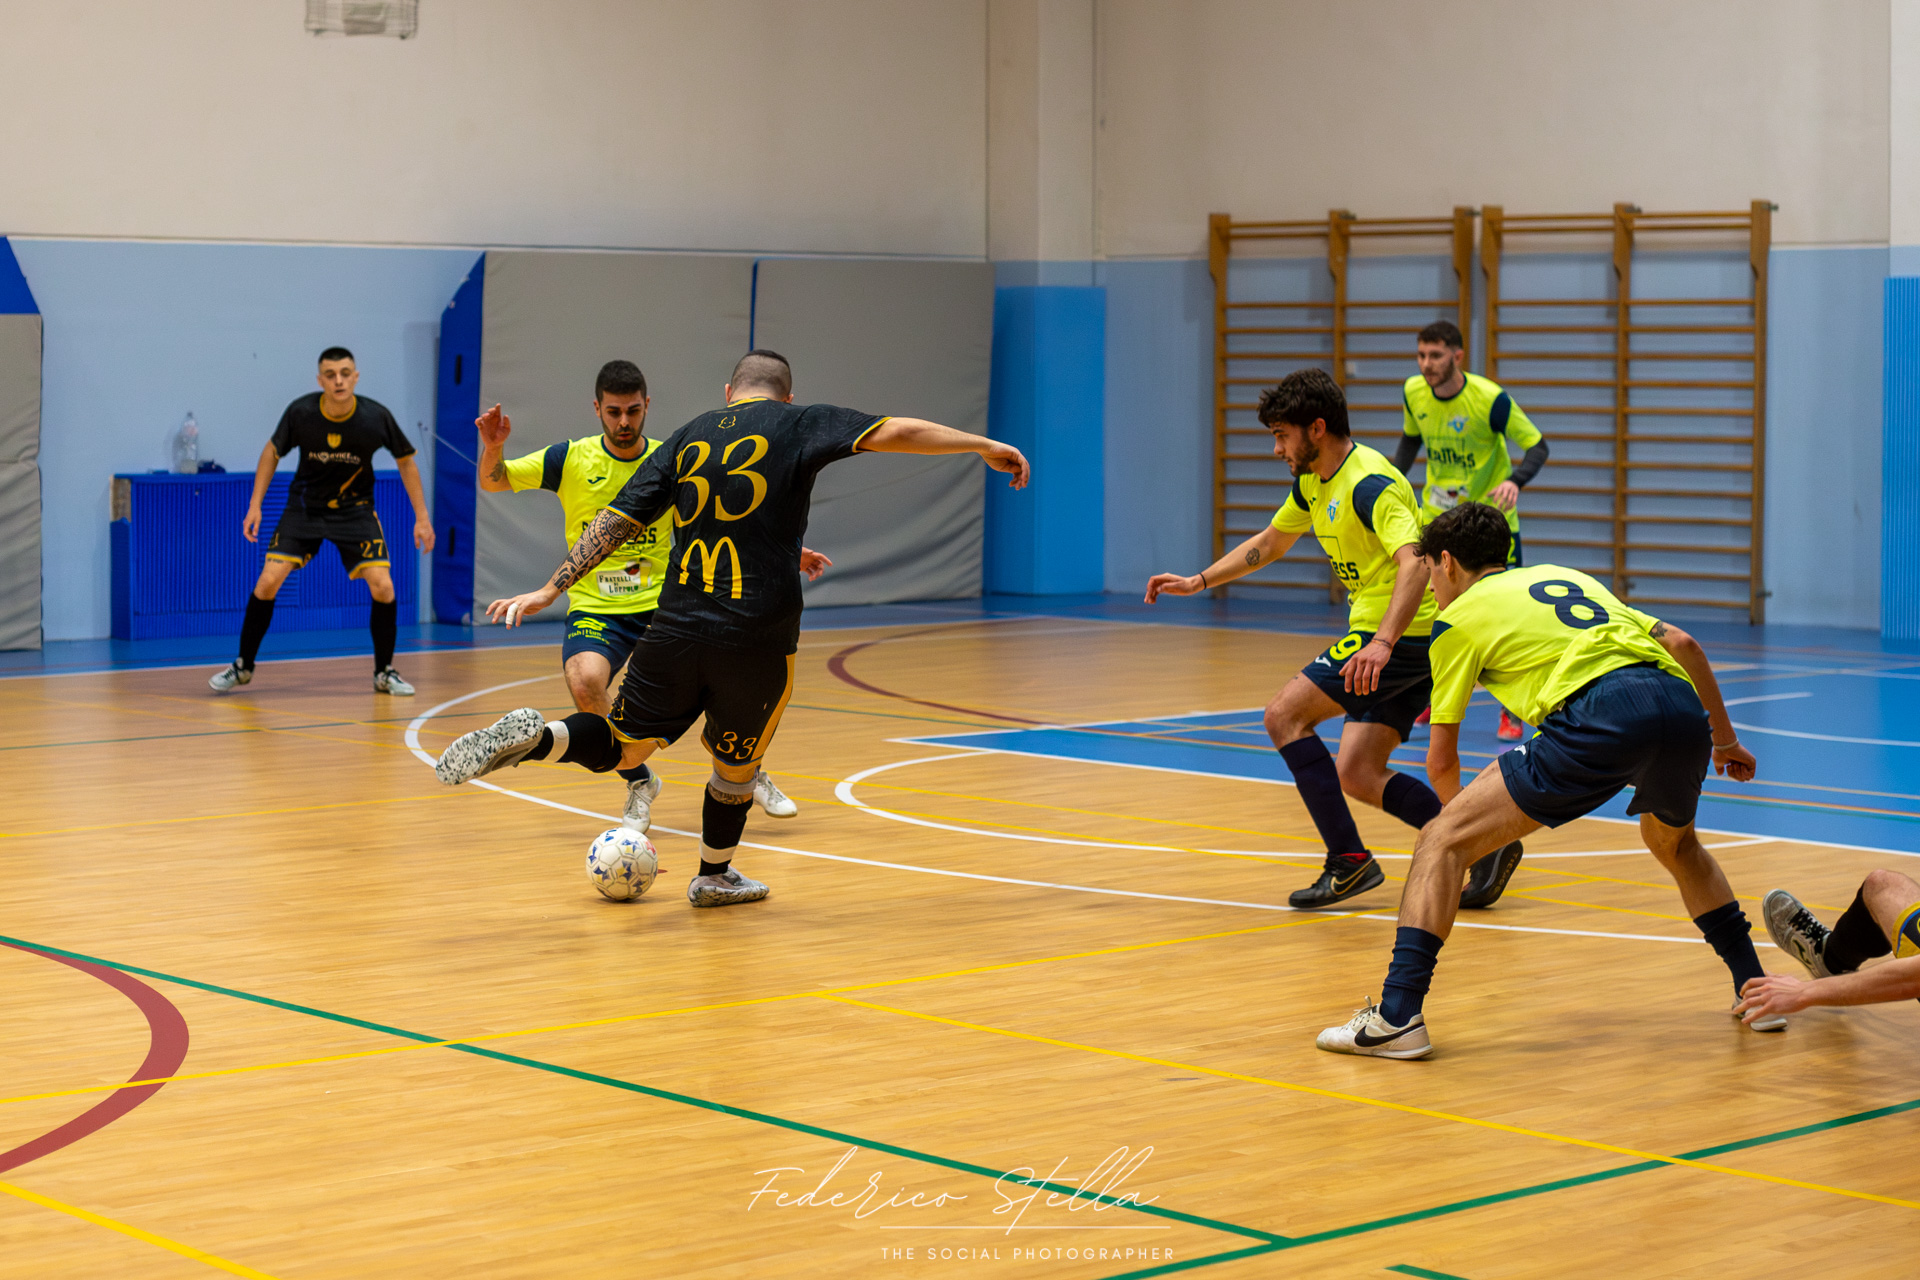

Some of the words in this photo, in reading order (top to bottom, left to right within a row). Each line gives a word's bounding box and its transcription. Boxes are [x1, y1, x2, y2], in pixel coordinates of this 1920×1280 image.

[673, 434, 769, 528] 33
[360, 539, 383, 558] 27
[1528, 579, 1610, 630] 8
[1329, 633, 1362, 661] 9
[715, 731, 757, 760] 33
